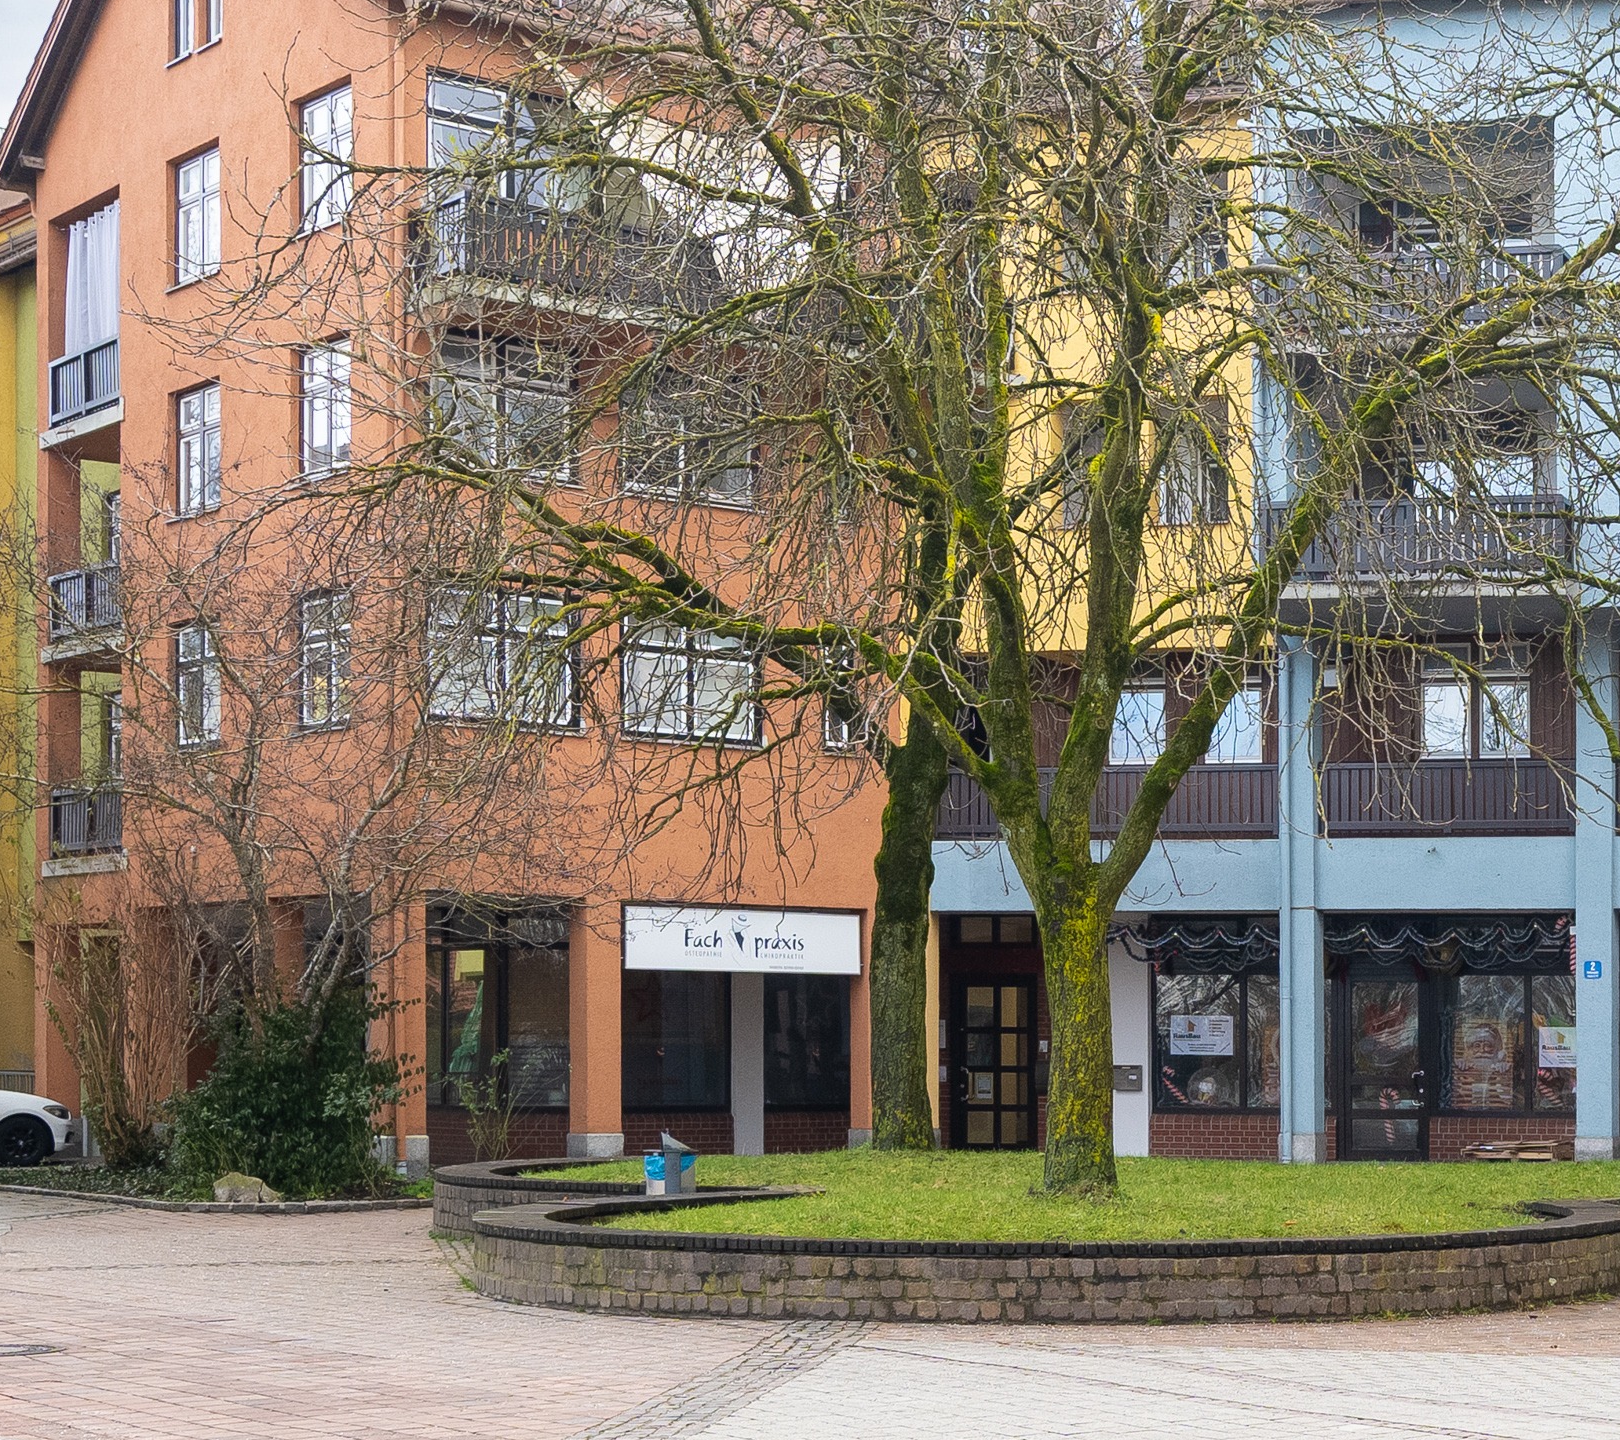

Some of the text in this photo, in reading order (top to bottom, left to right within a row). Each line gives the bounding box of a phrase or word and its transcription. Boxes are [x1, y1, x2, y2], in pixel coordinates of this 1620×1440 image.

[684, 929, 805, 958] Fach praxis
[684, 950, 722, 958] OSTEOPATHIE
[760, 952, 804, 960] CHIROPRAKTIK
[1590, 961, 1596, 971] 2
